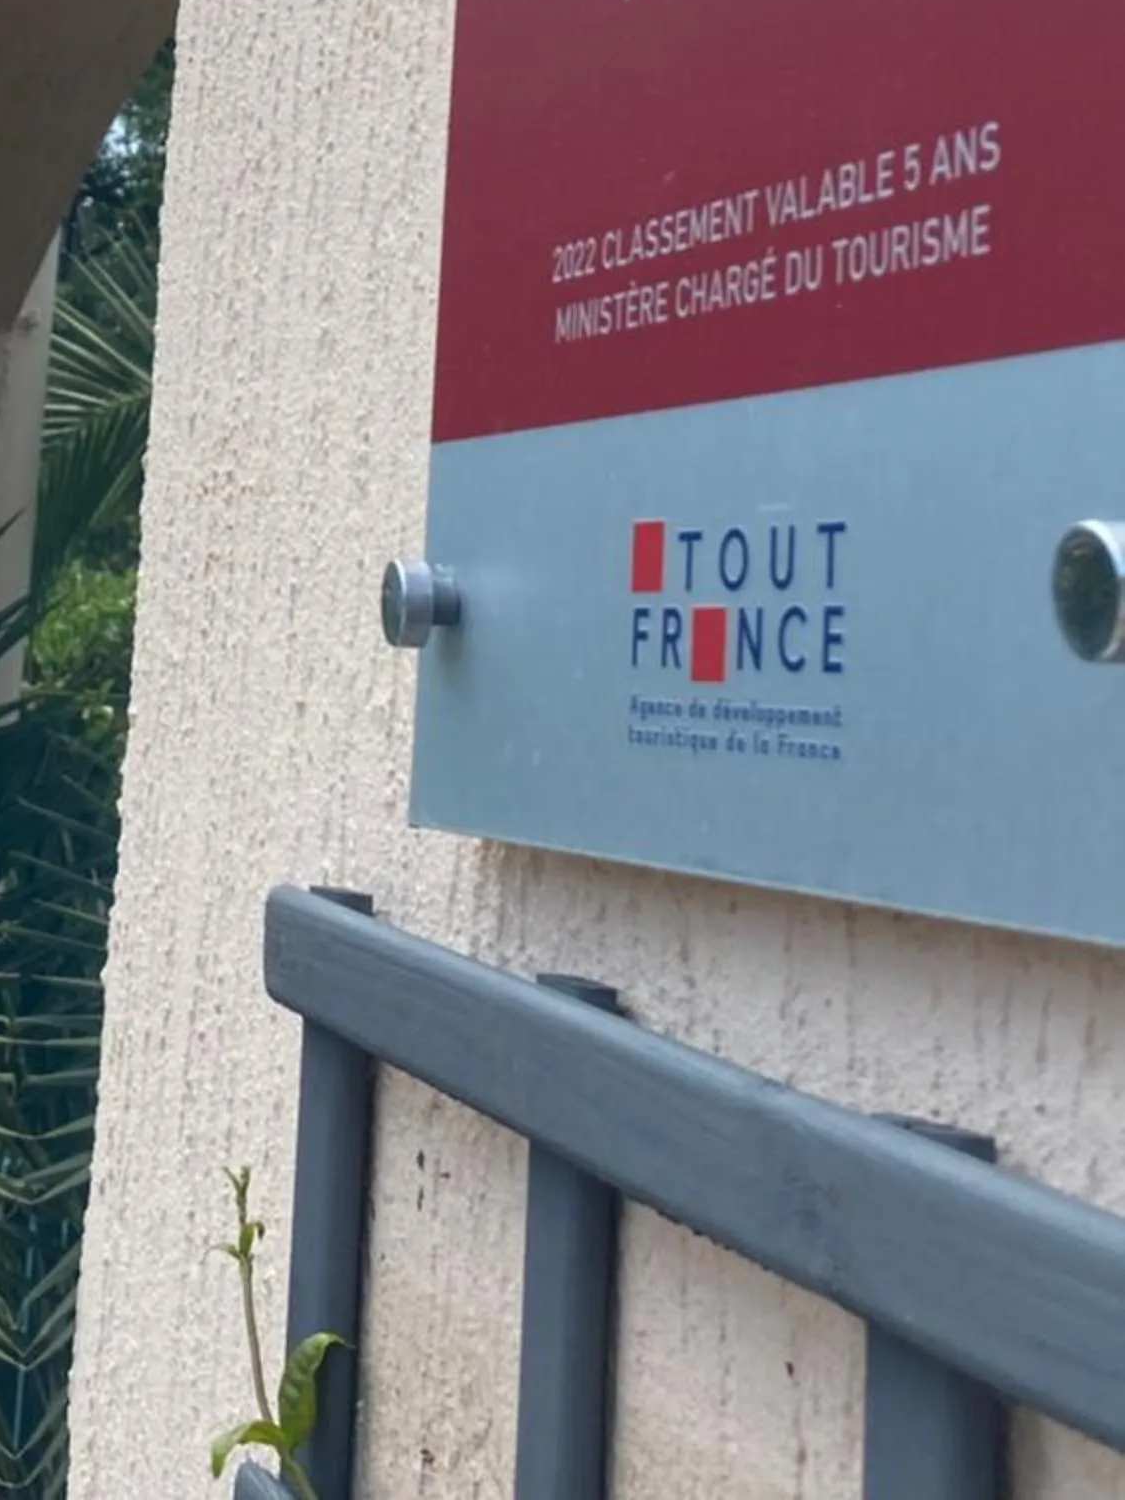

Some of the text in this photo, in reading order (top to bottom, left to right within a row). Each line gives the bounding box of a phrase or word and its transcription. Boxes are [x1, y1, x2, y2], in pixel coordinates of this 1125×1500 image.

[552, 121, 1001, 284] 2022 CLASSEMENT VALABLE 5 ANS
[554, 205, 993, 344] MINISTÈRE CHARGÉ DU TOURISME
[631, 604, 845, 683] FRNCE
[688, 699, 707, 719] de
[725, 731, 746, 753] de
[753, 734, 770, 755] la
[777, 733, 843, 760] France
